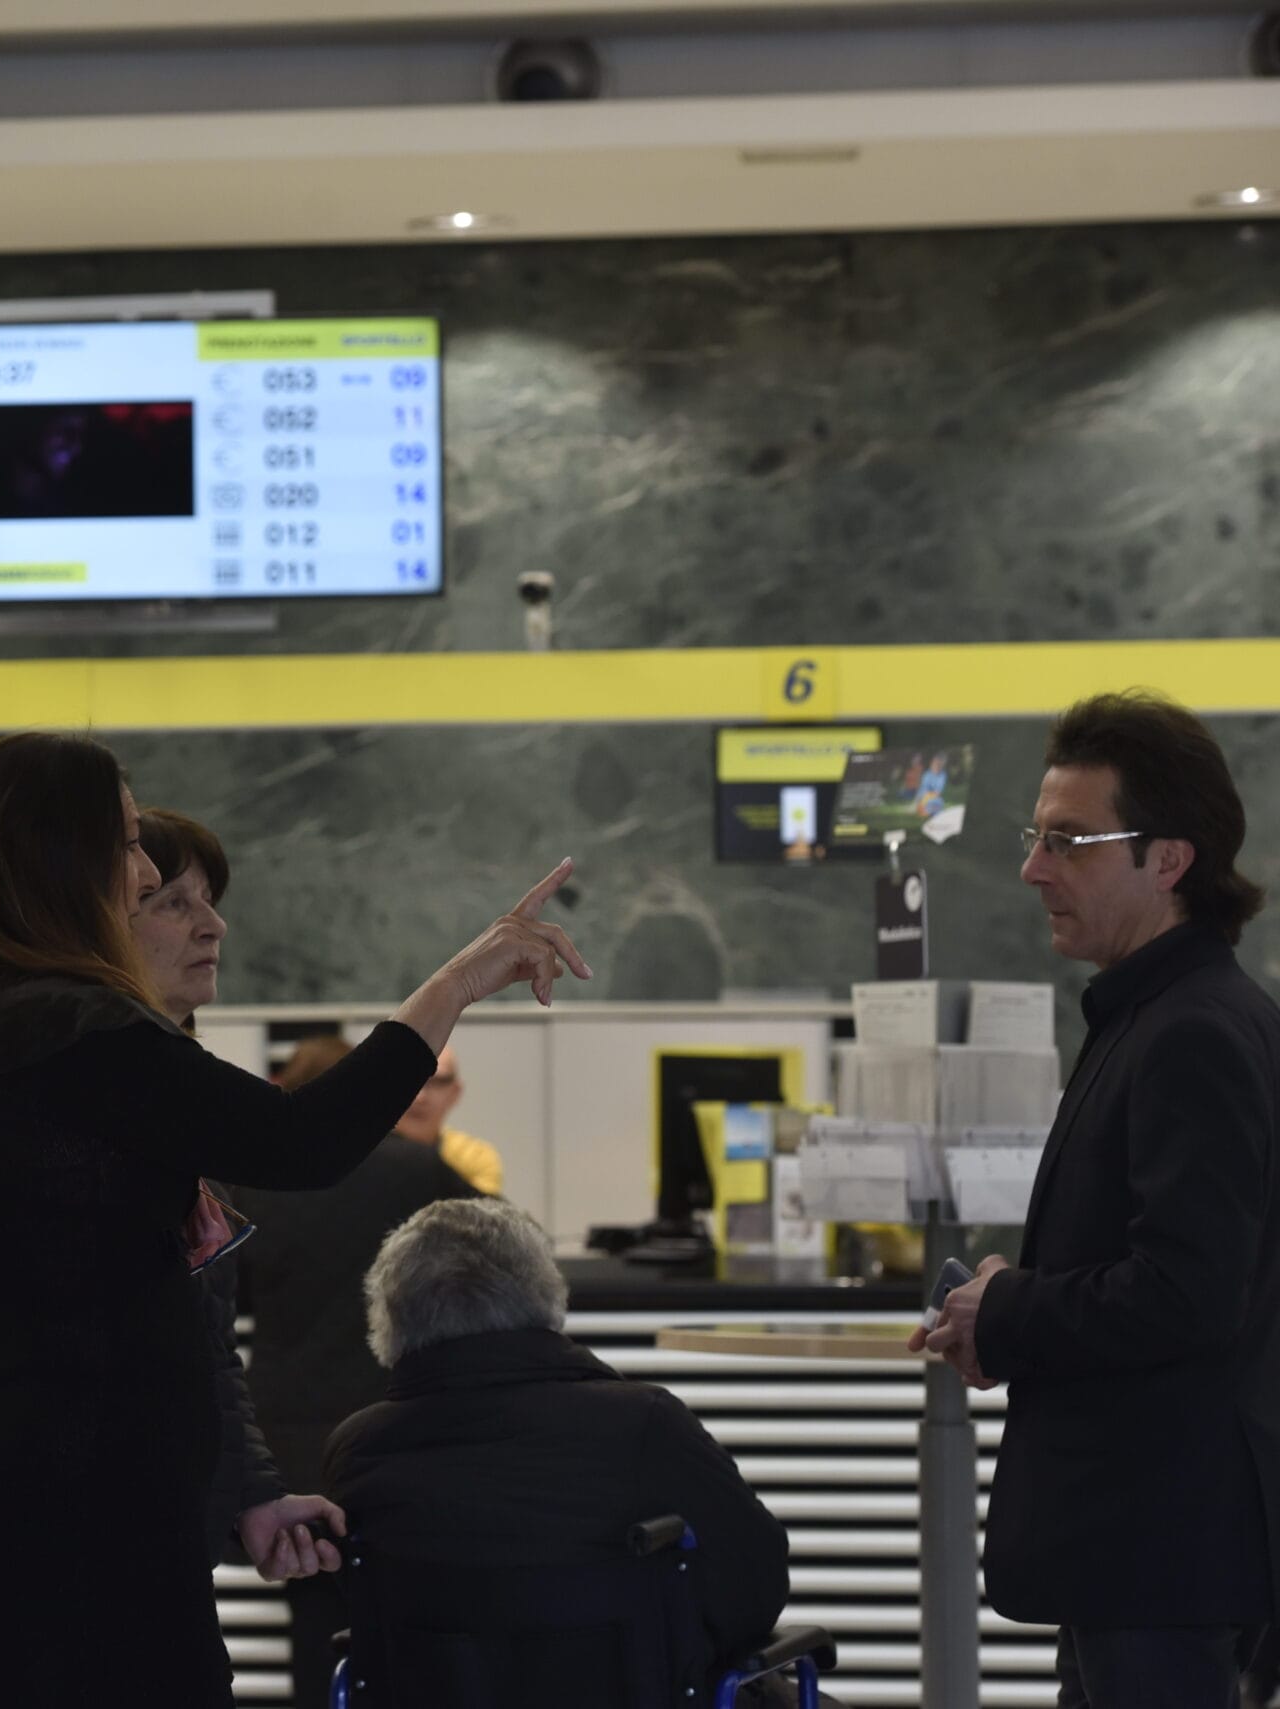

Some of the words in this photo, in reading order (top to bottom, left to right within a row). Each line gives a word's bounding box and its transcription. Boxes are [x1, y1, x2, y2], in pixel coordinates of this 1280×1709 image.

[263, 367, 318, 393] 053
[389, 365, 427, 390] 09
[263, 405, 318, 432] 052
[395, 405, 423, 429] 11
[263, 444, 315, 470] 051
[390, 442, 427, 468] 09
[263, 482, 319, 509] 020
[395, 482, 426, 505] 14
[264, 521, 319, 547] 012
[391, 519, 424, 545] 01
[264, 559, 316, 585] 011
[396, 558, 427, 581] 14
[782, 658, 817, 704] 6
